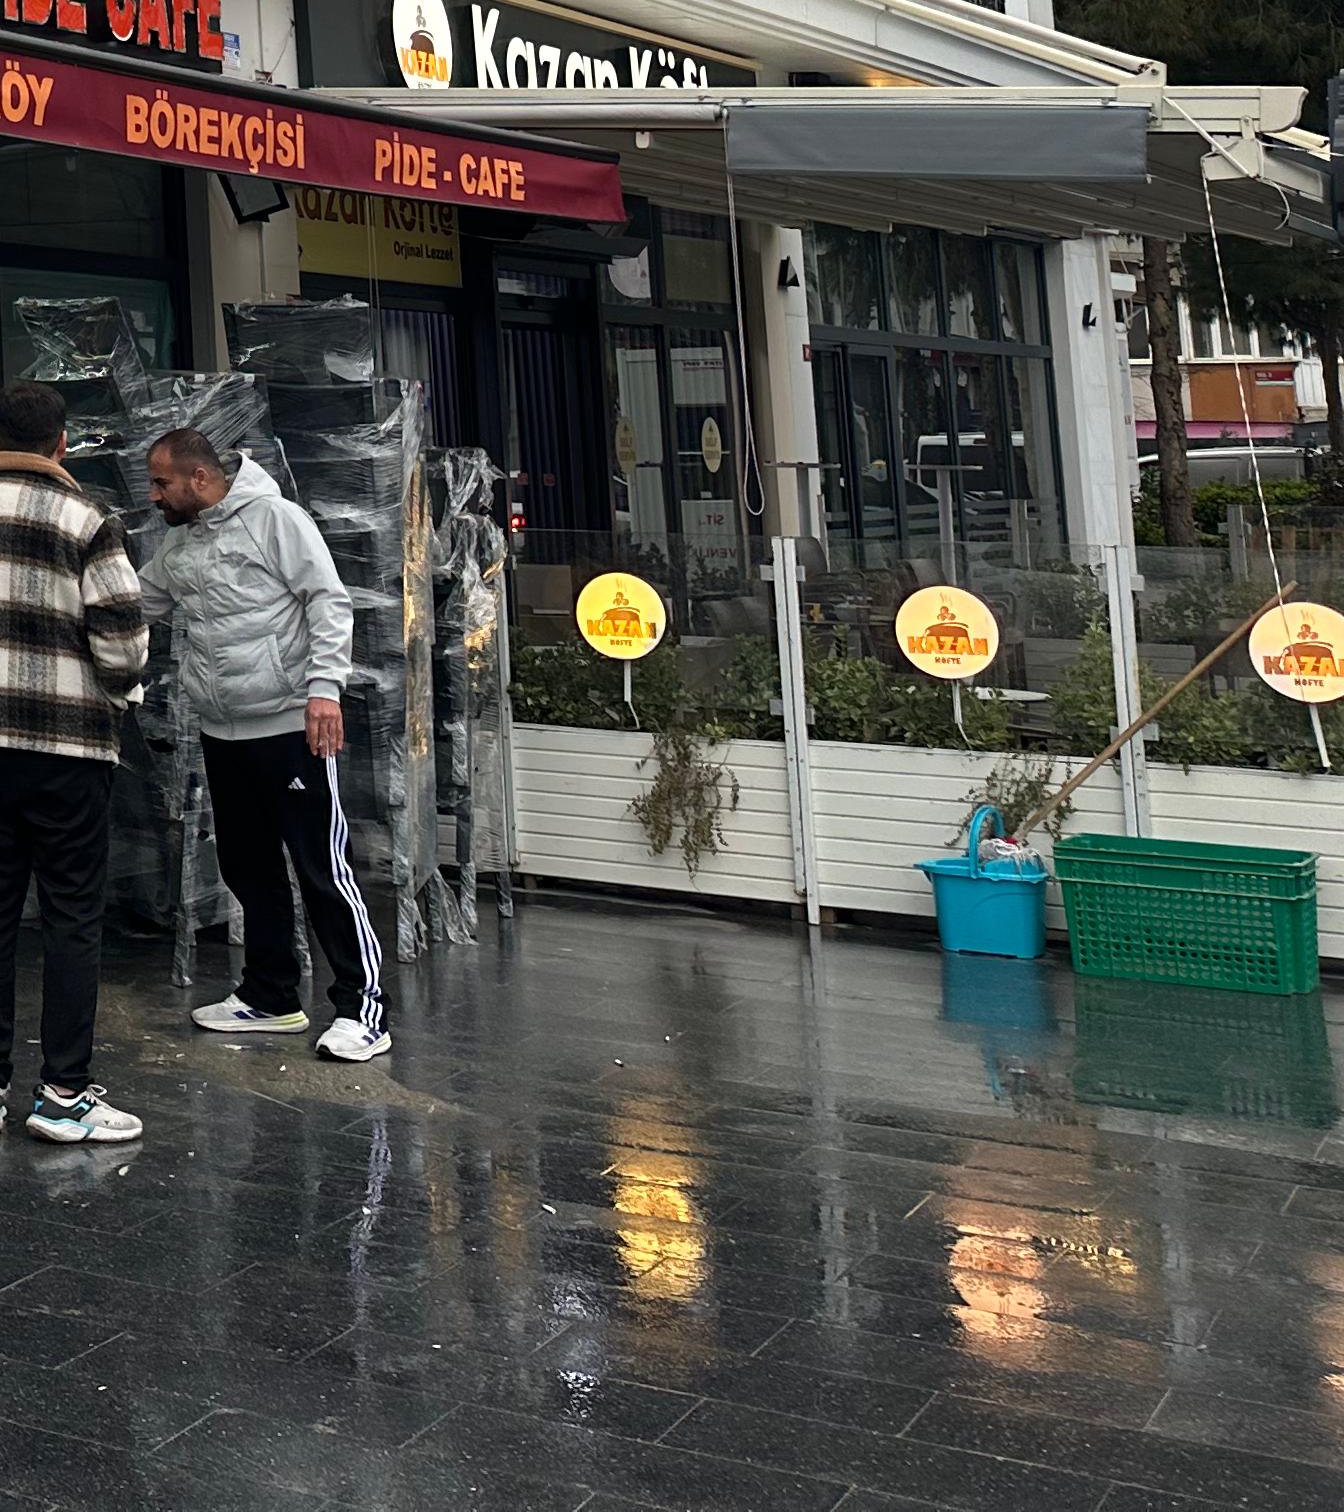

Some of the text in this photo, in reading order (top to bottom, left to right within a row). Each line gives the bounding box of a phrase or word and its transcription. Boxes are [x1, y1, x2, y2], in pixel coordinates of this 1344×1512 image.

[125, 95, 306, 176] BÖREKÇİSİ
[374, 137, 436, 190] PİDE
[460, 153, 525, 201] CAFE
